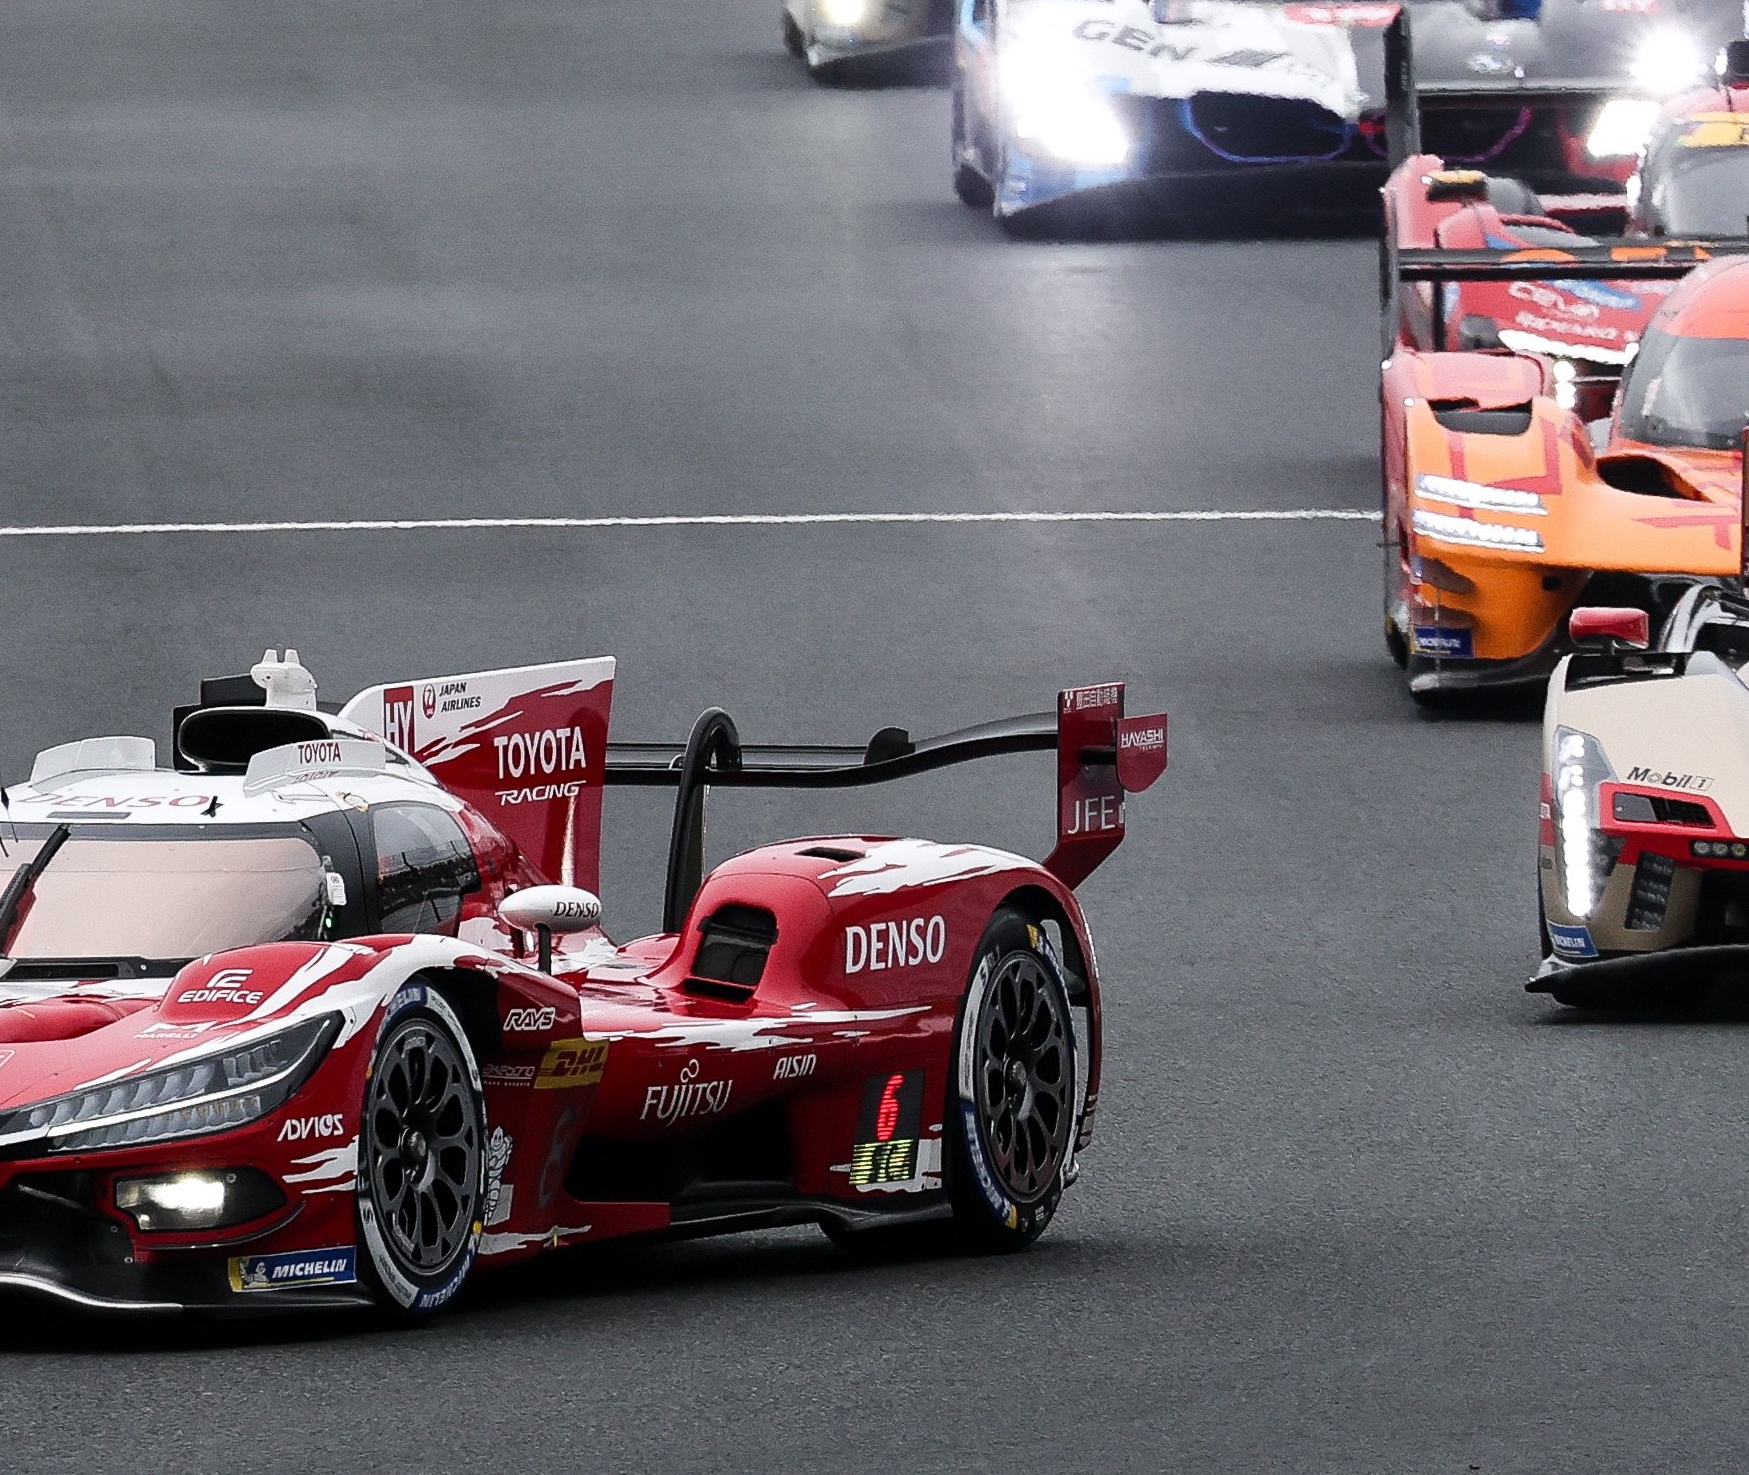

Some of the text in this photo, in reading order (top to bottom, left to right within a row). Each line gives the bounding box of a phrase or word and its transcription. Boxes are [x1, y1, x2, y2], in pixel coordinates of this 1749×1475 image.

[439, 682, 467, 697] JAPAN
[441, 696, 482, 713] AIRLINES
[1121, 728, 1164, 749] HAYASHI
[297, 742, 341, 765] TOYOTA
[494, 726, 587, 779] TOYOTA
[1627, 766, 1691, 789] Mobil
[17, 794, 210, 808] DENSO
[495, 780, 587, 806] RACING
[1067, 795, 1116, 835] JFE
[554, 901, 600, 918] DENSO
[845, 916, 946, 974] DENSO
[177, 989, 264, 1004] EDIFICE
[503, 1007, 556, 1031] RAYS
[773, 1053, 817, 1080] AISIN
[640, 1079, 733, 1127] FUJITSU
[876, 1074, 905, 1141] 6
[272, 1258, 348, 1278] MICHELIN
